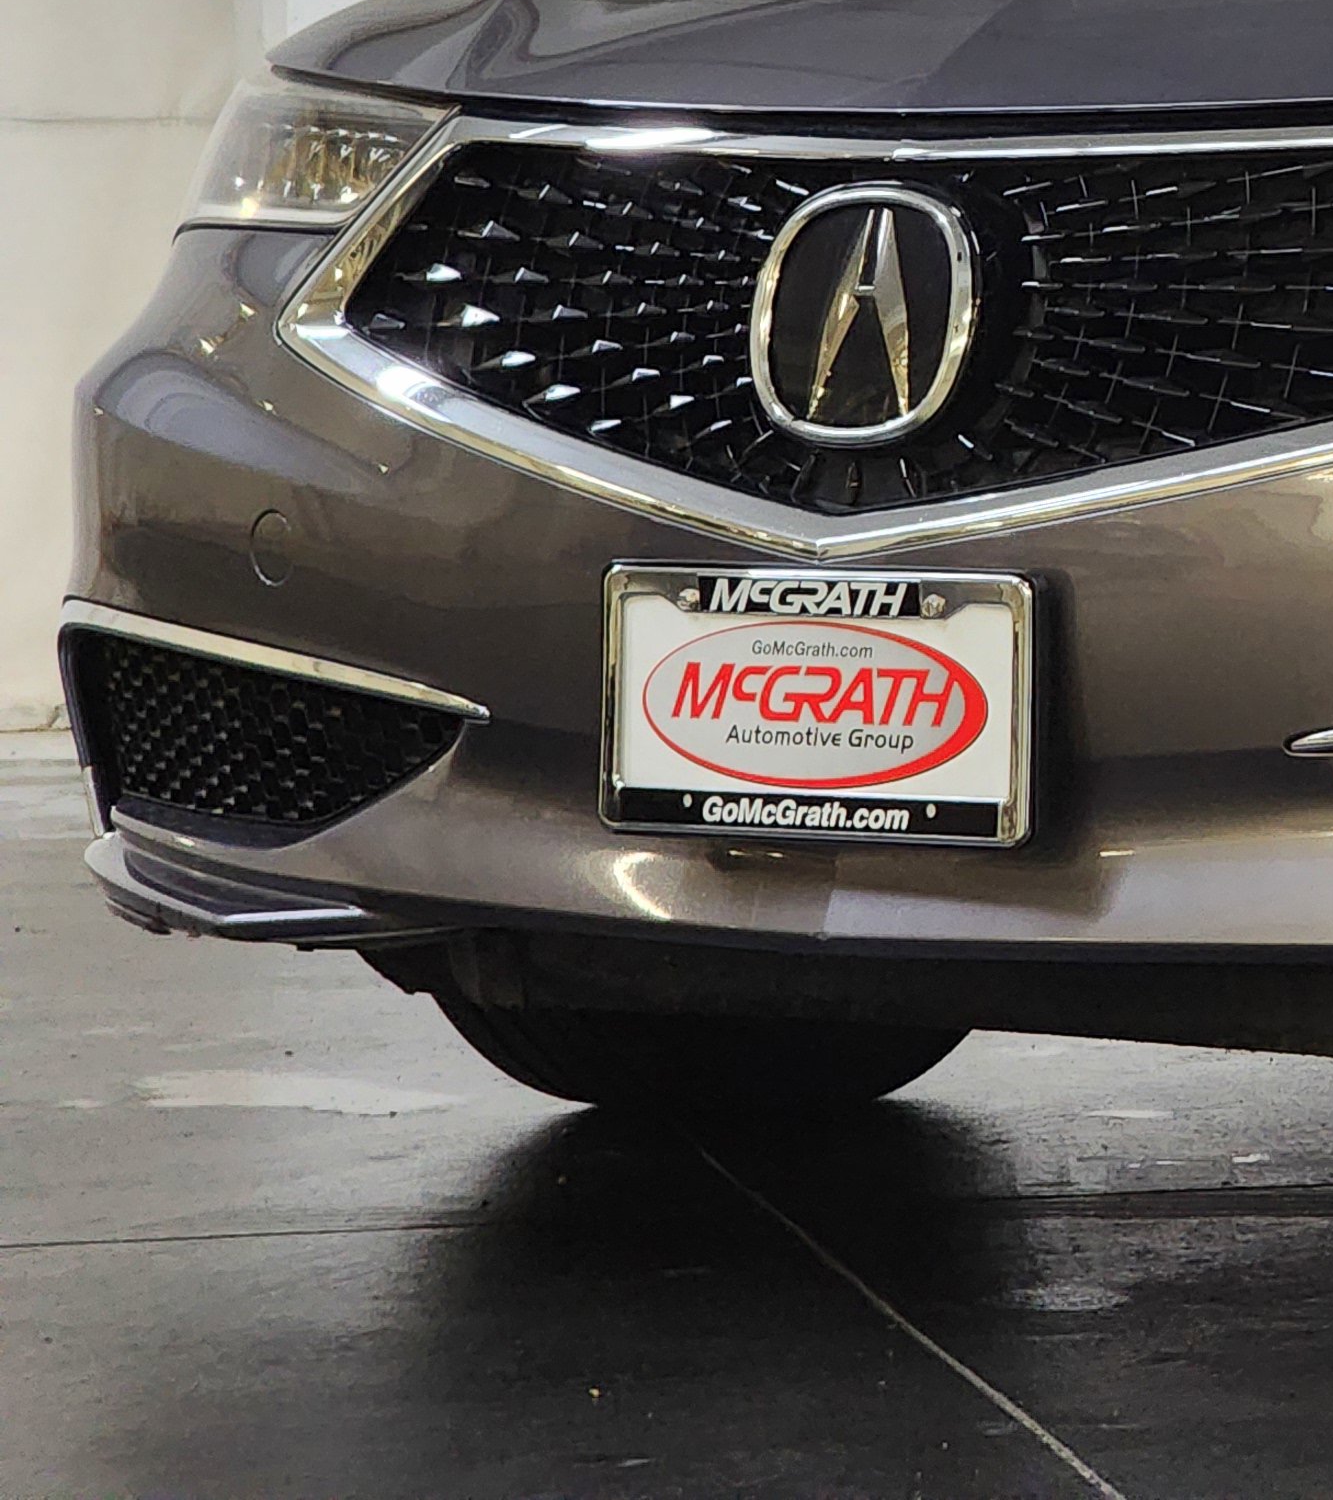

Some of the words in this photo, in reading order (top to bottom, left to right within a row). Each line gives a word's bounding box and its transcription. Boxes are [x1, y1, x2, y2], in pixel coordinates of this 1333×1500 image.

[751, 640, 874, 659] GoMcGrath.com
[725, 726, 842, 749] Automotive
[847, 729, 915, 753] Group
[702, 796, 910, 831] GoMcGrath.com
